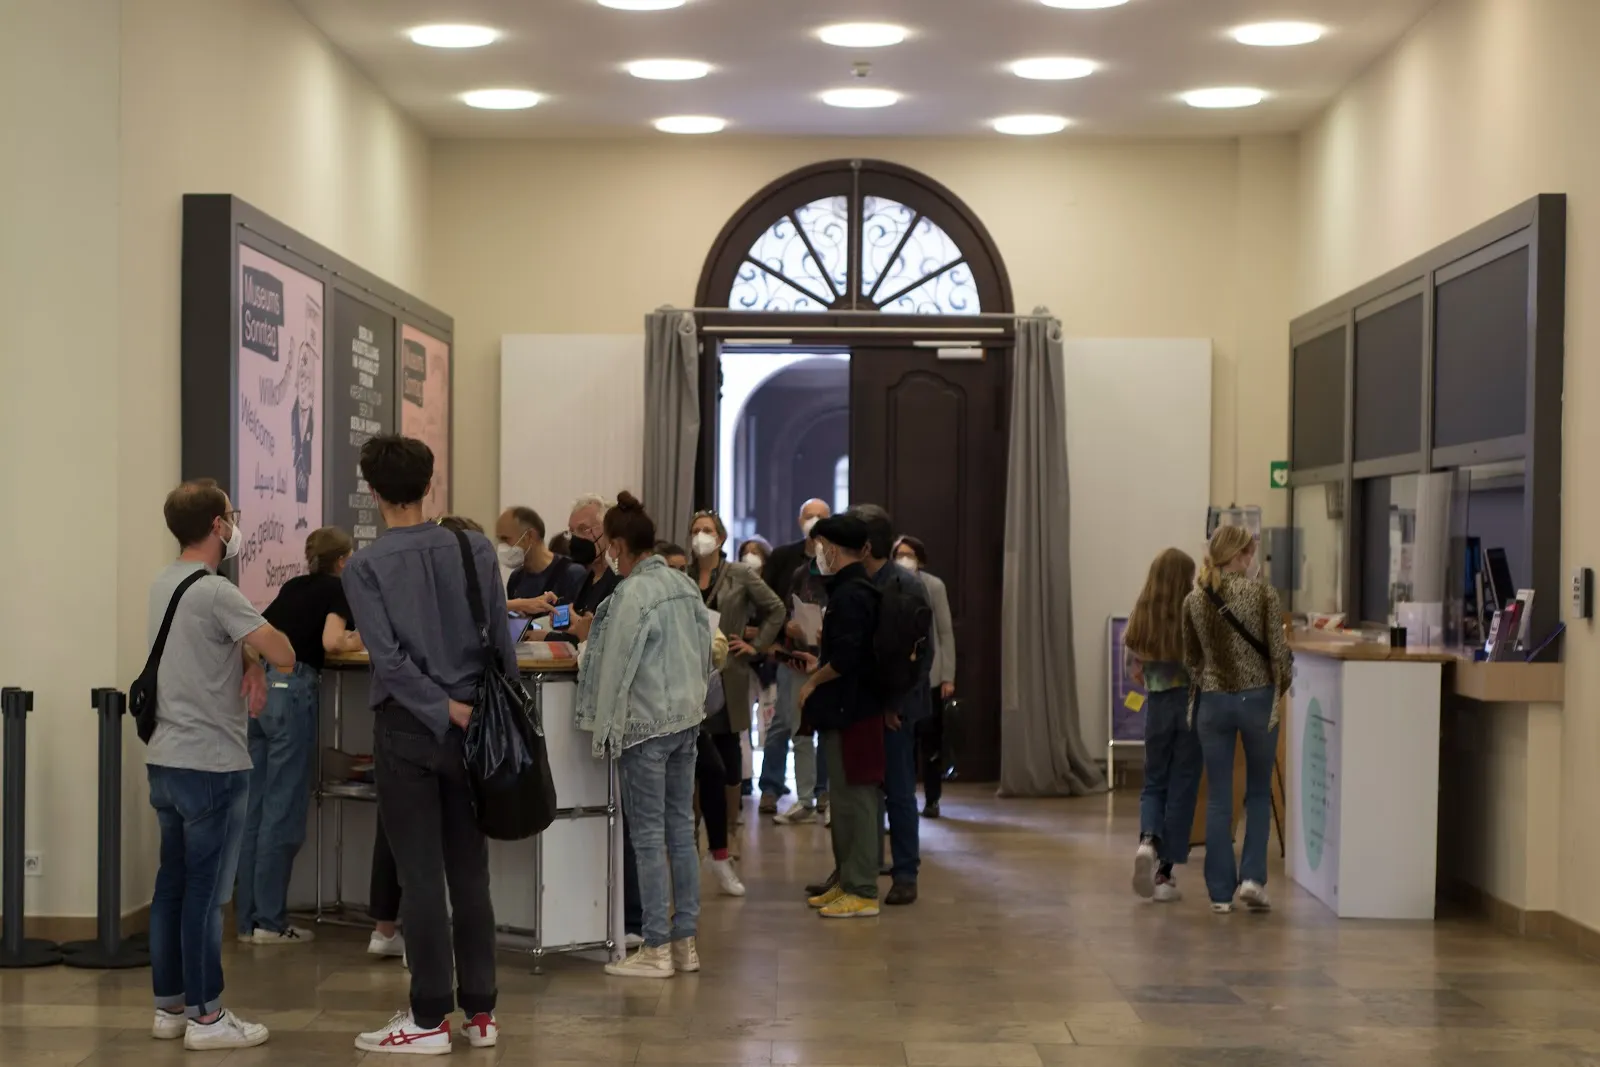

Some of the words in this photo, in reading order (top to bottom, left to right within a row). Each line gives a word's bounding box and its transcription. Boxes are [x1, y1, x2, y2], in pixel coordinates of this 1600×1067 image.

[244, 273, 280, 315] Museums
[244, 308, 277, 357] Sonntag
[241, 390, 275, 458] Welcome
